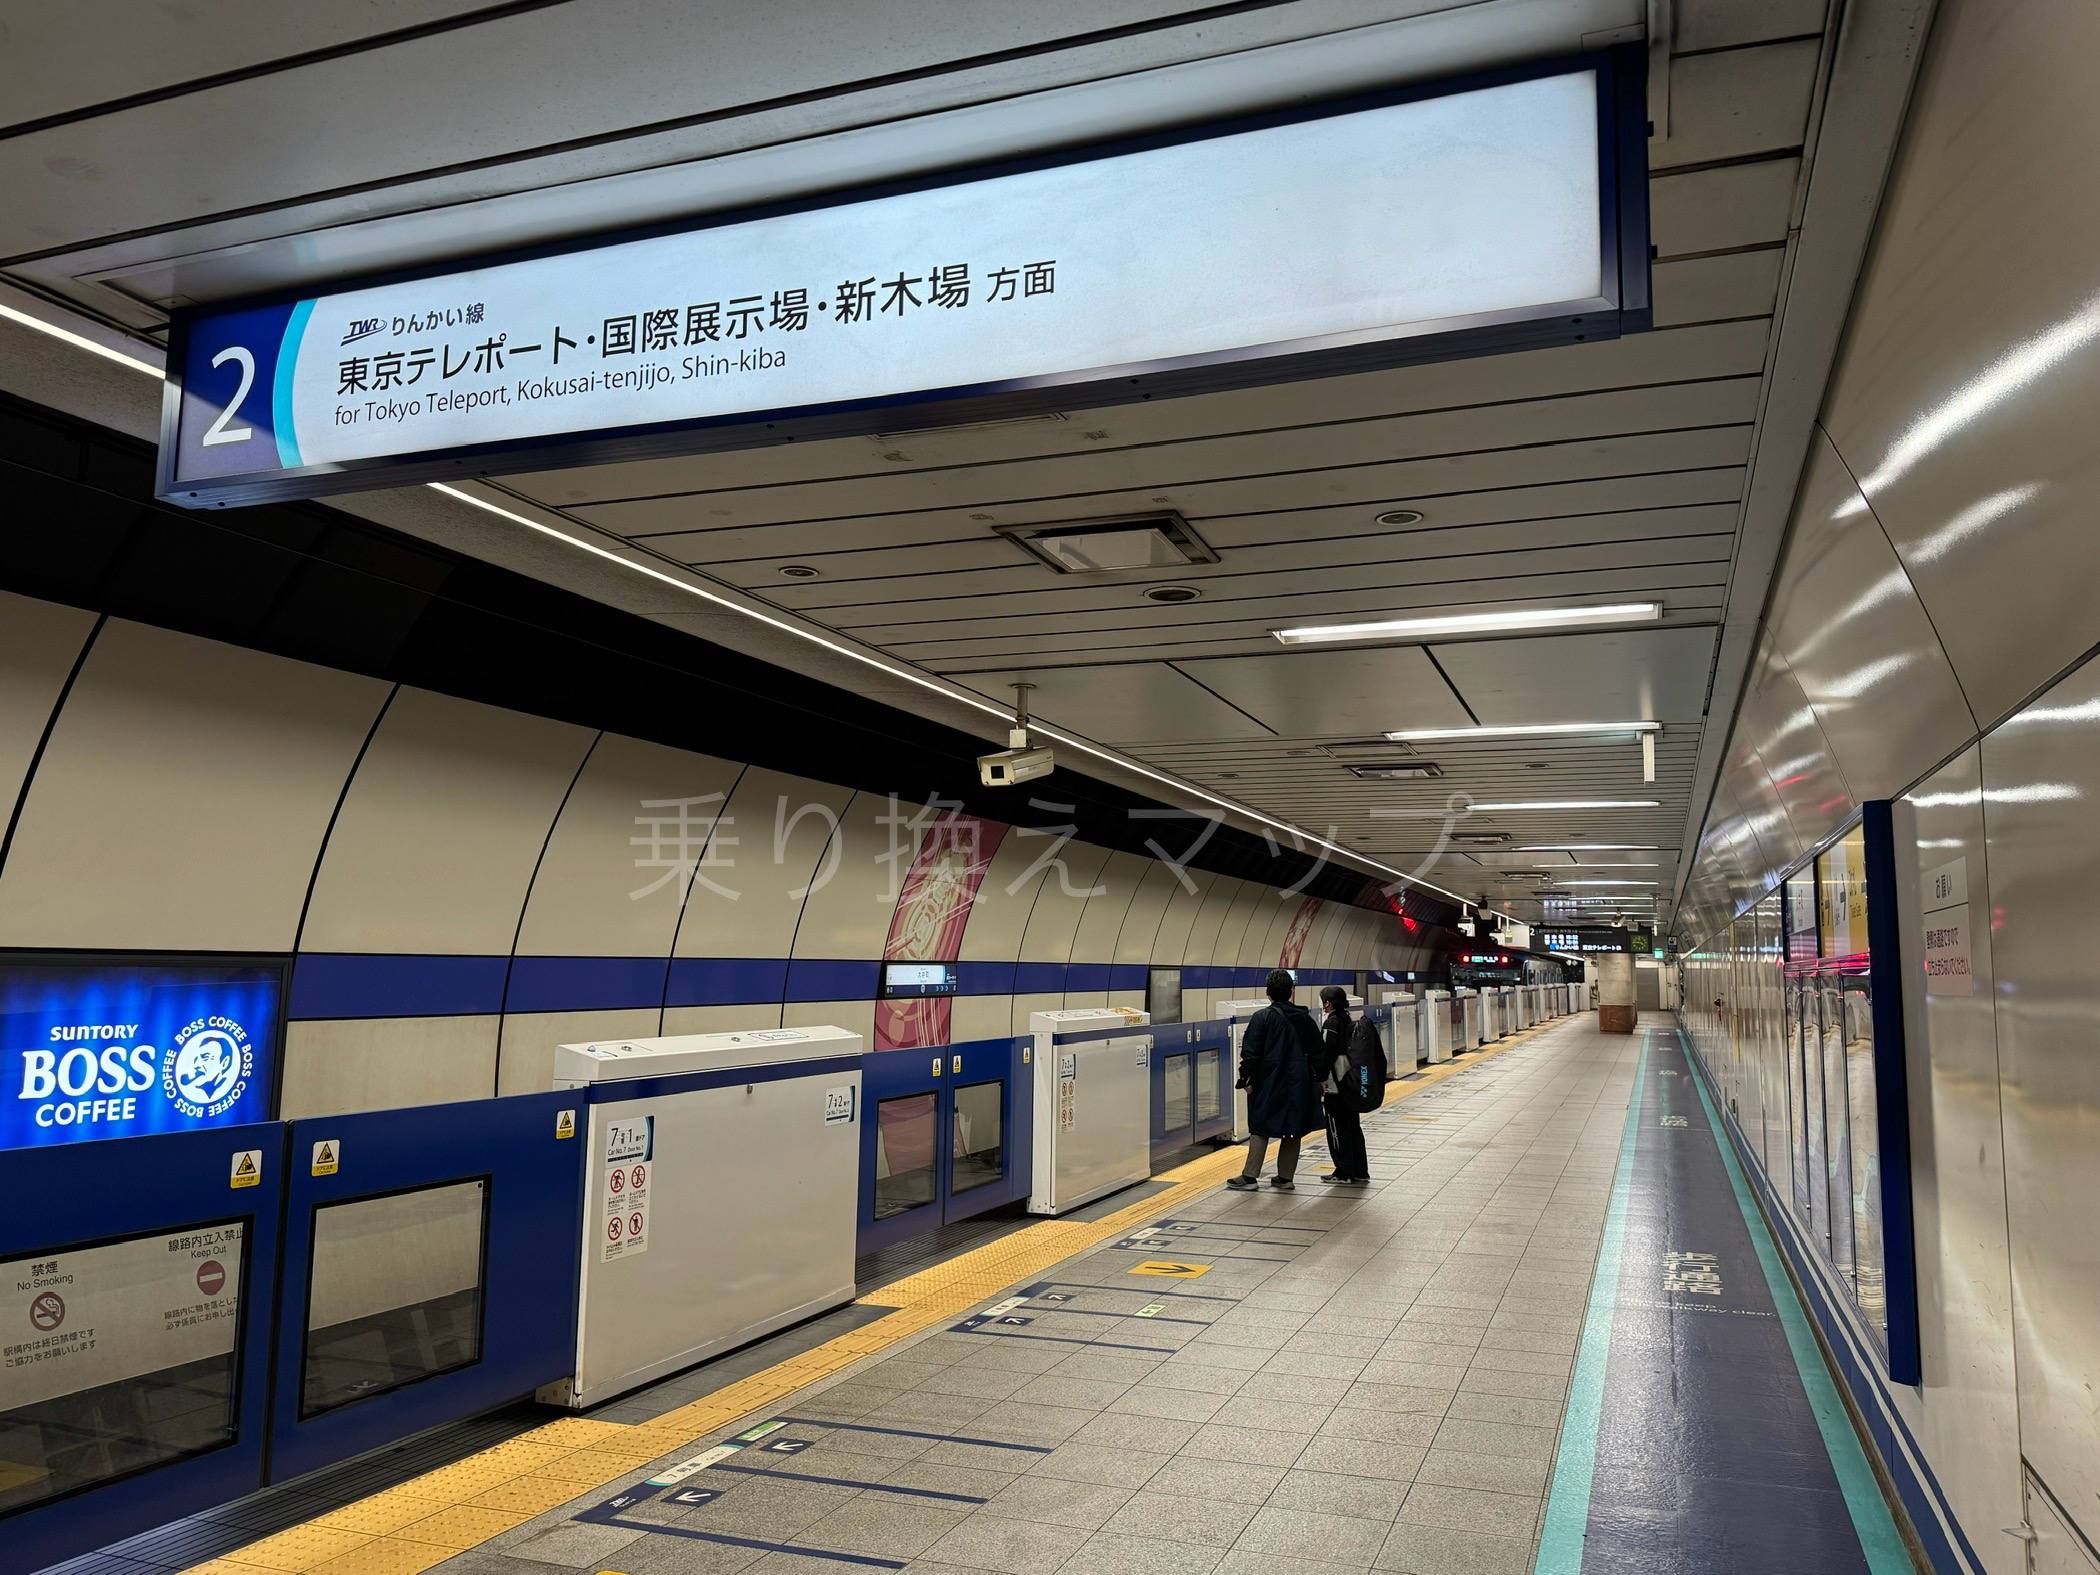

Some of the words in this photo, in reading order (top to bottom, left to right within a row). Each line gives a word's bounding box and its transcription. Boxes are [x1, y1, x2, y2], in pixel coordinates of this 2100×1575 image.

[337, 263, 970, 396] 東京テレポート・国際展示場・新木場
[986, 259, 1057, 304] 方面
[391, 302, 485, 337] りんかい線
[203, 346, 255, 447] 2
[335, 405, 361, 426] for
[365, 400, 421, 423] Tokyo
[426, 384, 512, 413] Teleport,
[517, 361, 675, 402] Kokusai-tenjijo,
[681, 347, 787, 382] Shin-kiba
[174, 1018, 205, 1046] BOSS
[208, 1015, 248, 1043] COFFEE
[18, 1045, 156, 1099] BOSS
[162, 1048, 177, 1100] COFFEE
[241, 1043, 253, 1077] BOSS
[35, 1098, 136, 1127] COFFEE
[174, 1097, 204, 1118] BOSS
[208, 1081, 247, 1117] COFFEE
[168, 1227, 243, 1252] 線路内立入禁止
[191, 1249, 212, 1259] Keep
[213, 1245, 227, 1255] Out
[17, 1281, 31, 1291] No
[33, 1273, 74, 1289] Smoking
[31, 1260, 59, 1277] 禁煙
[3, 1328, 95, 1357] 駅構内は終日禁煙です
[5, 1339, 97, 1368] ご協力をお願いします
